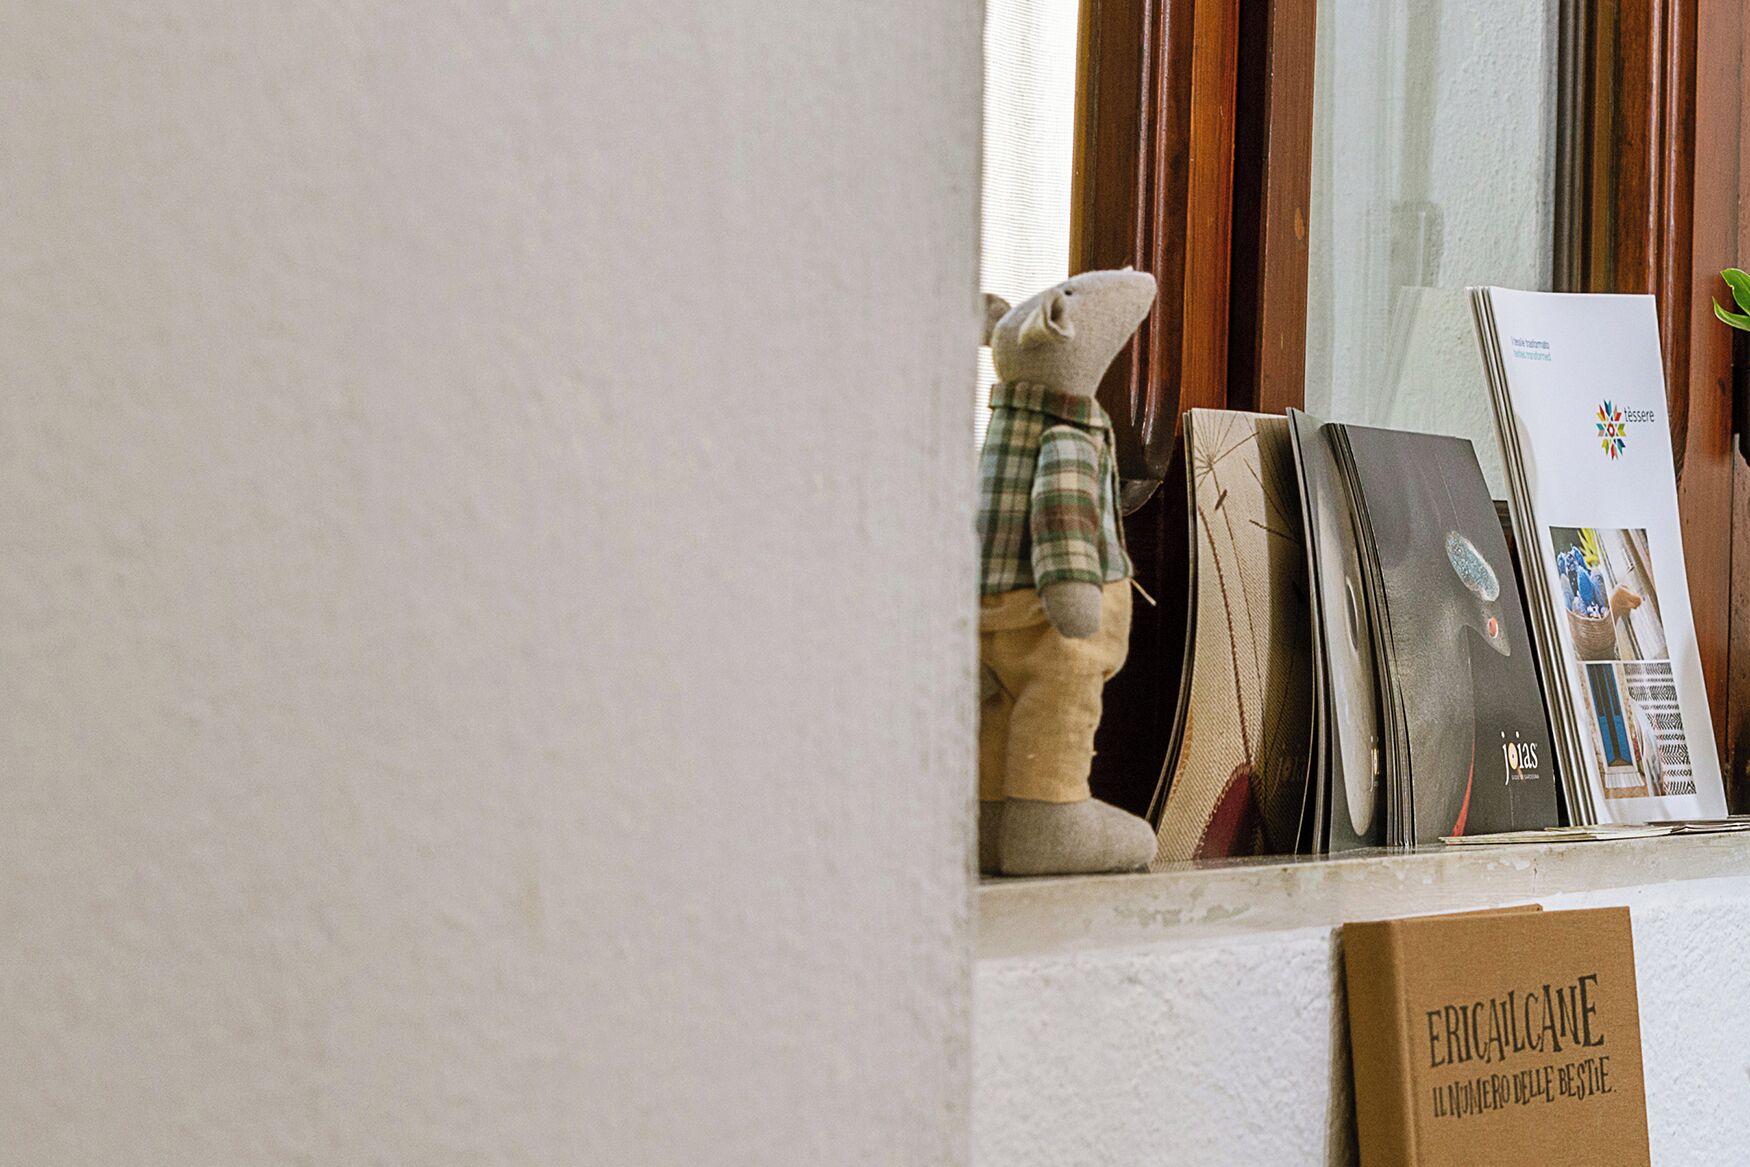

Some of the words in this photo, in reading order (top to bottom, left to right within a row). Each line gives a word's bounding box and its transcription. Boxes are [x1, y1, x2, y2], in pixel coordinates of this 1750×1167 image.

[1624, 406, 1655, 423] tèssere
[1500, 730, 1538, 786] joias
[1426, 973, 1605, 1068] ERICAILCANE
[1433, 1086, 1447, 1117] IL
[1448, 1073, 1511, 1118] NUMERO
[1513, 1065, 1554, 1105] DELLE
